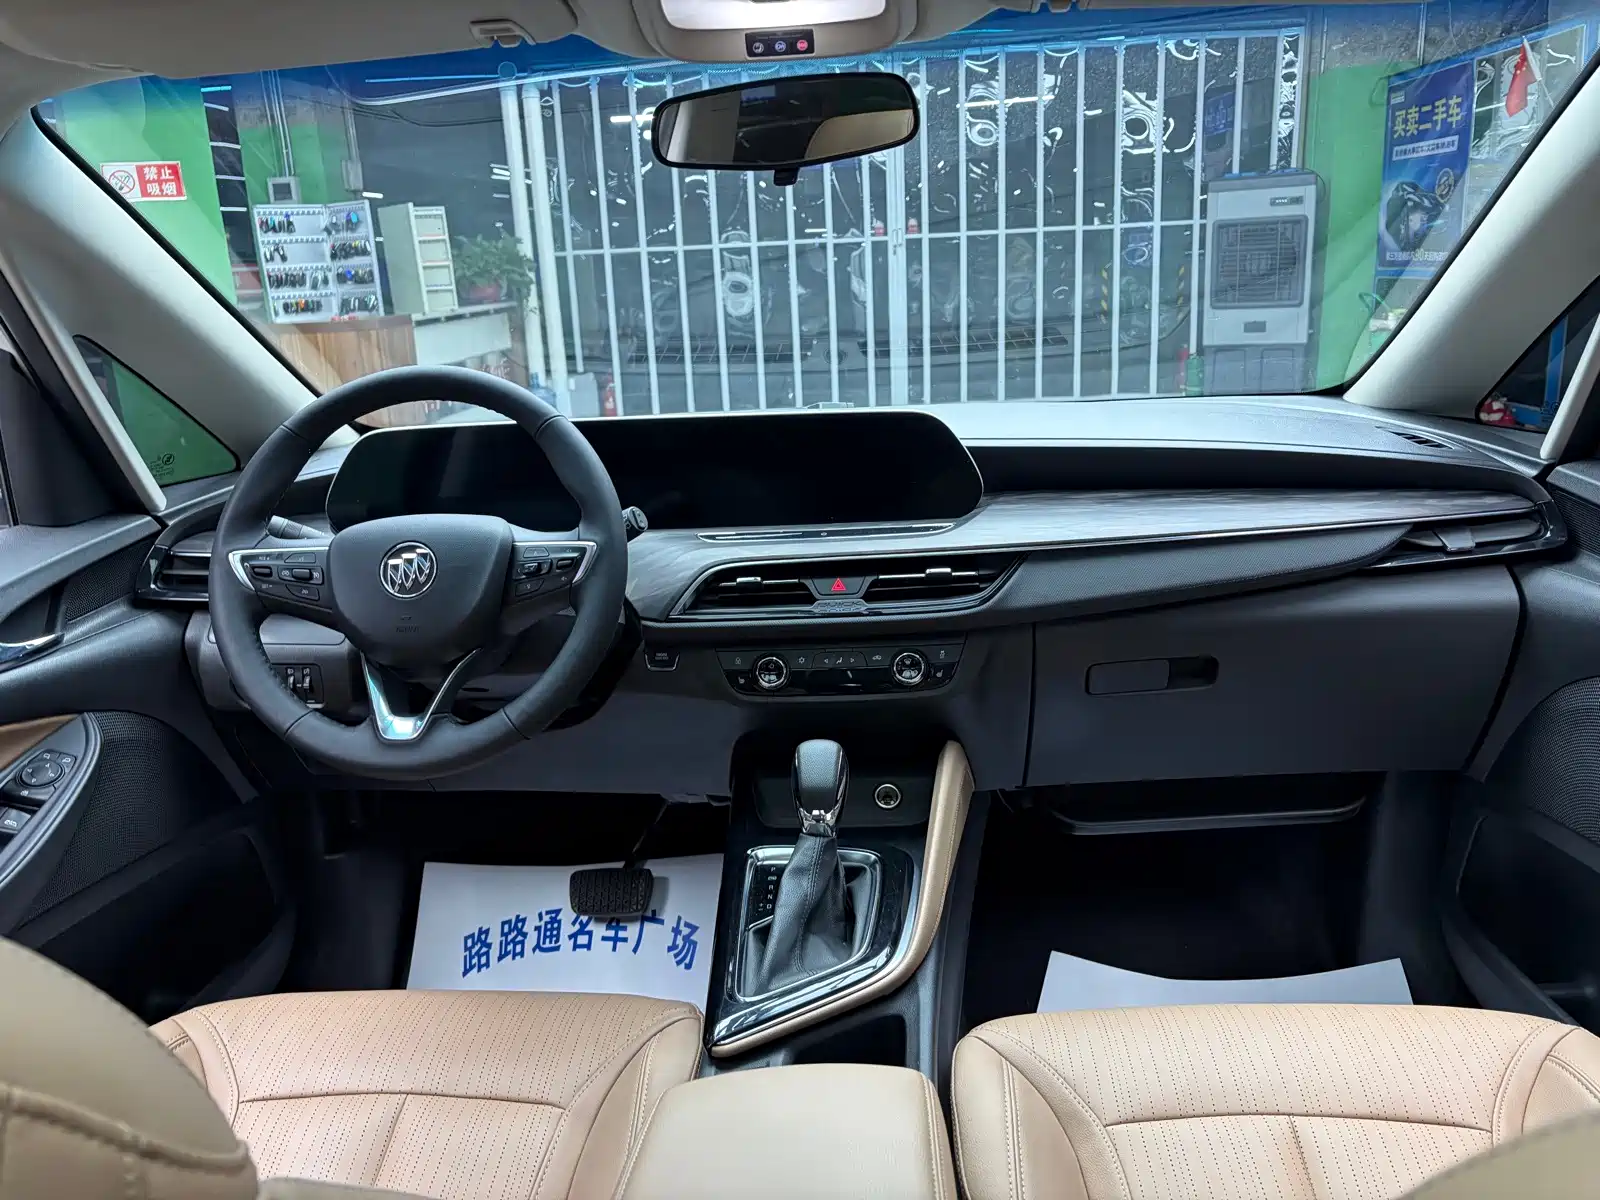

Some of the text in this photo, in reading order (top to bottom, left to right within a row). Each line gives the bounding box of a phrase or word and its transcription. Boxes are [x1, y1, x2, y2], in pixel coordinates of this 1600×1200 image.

[1393, 95, 1462, 139] 买卖二手车
[143, 166, 175, 180] 禁止
[146, 182, 177, 196] 吸烟
[461, 908, 700, 978] 路路通名车广场
